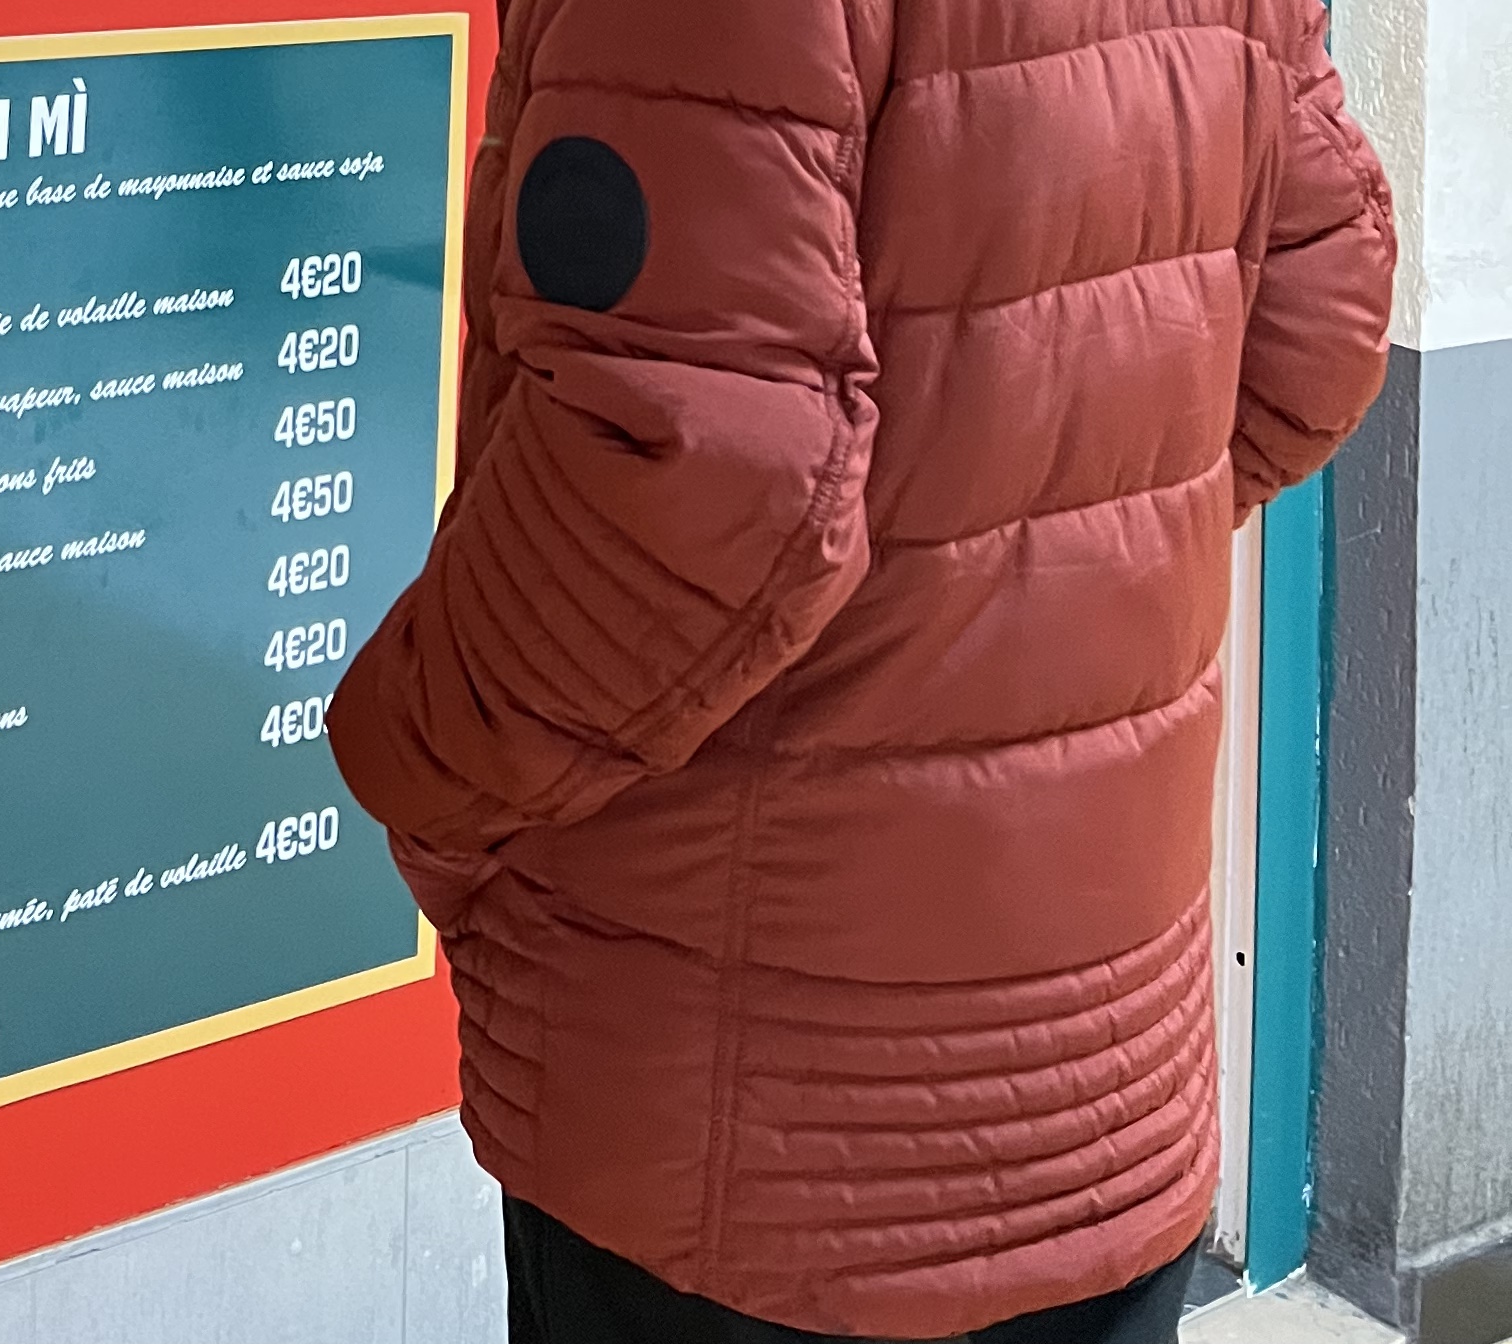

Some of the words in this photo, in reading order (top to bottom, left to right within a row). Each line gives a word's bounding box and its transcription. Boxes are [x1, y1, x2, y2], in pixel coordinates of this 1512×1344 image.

[28, 77, 88, 158] MÌ
[25, 175, 77, 206] base
[83, 172, 112, 200] de
[117, 165, 246, 201] mayonnaise
[251, 160, 274, 185] et
[276, 159, 335, 182] sauce
[338, 150, 385, 181] soja
[19, 302, 50, 332] de
[56, 290, 147, 328] volaille
[152, 288, 235, 315] maison
[280, 250, 362, 300] 4€20
[89, 373, 156, 401] sauce
[161, 362, 244, 391] maison
[277, 323, 360, 374] 4€20
[41, 455, 97, 496] frits
[273, 396, 356, 449] 4€50
[60, 529, 147, 561] maison
[270, 470, 354, 523] 4€50
[267, 544, 350, 598] 4€20
[263, 618, 347, 673] 4€20
[60, 877, 120, 923] paté
[123, 867, 154, 898] de
[159, 842, 248, 889] volaille
[255, 806, 339, 865] 4€90
